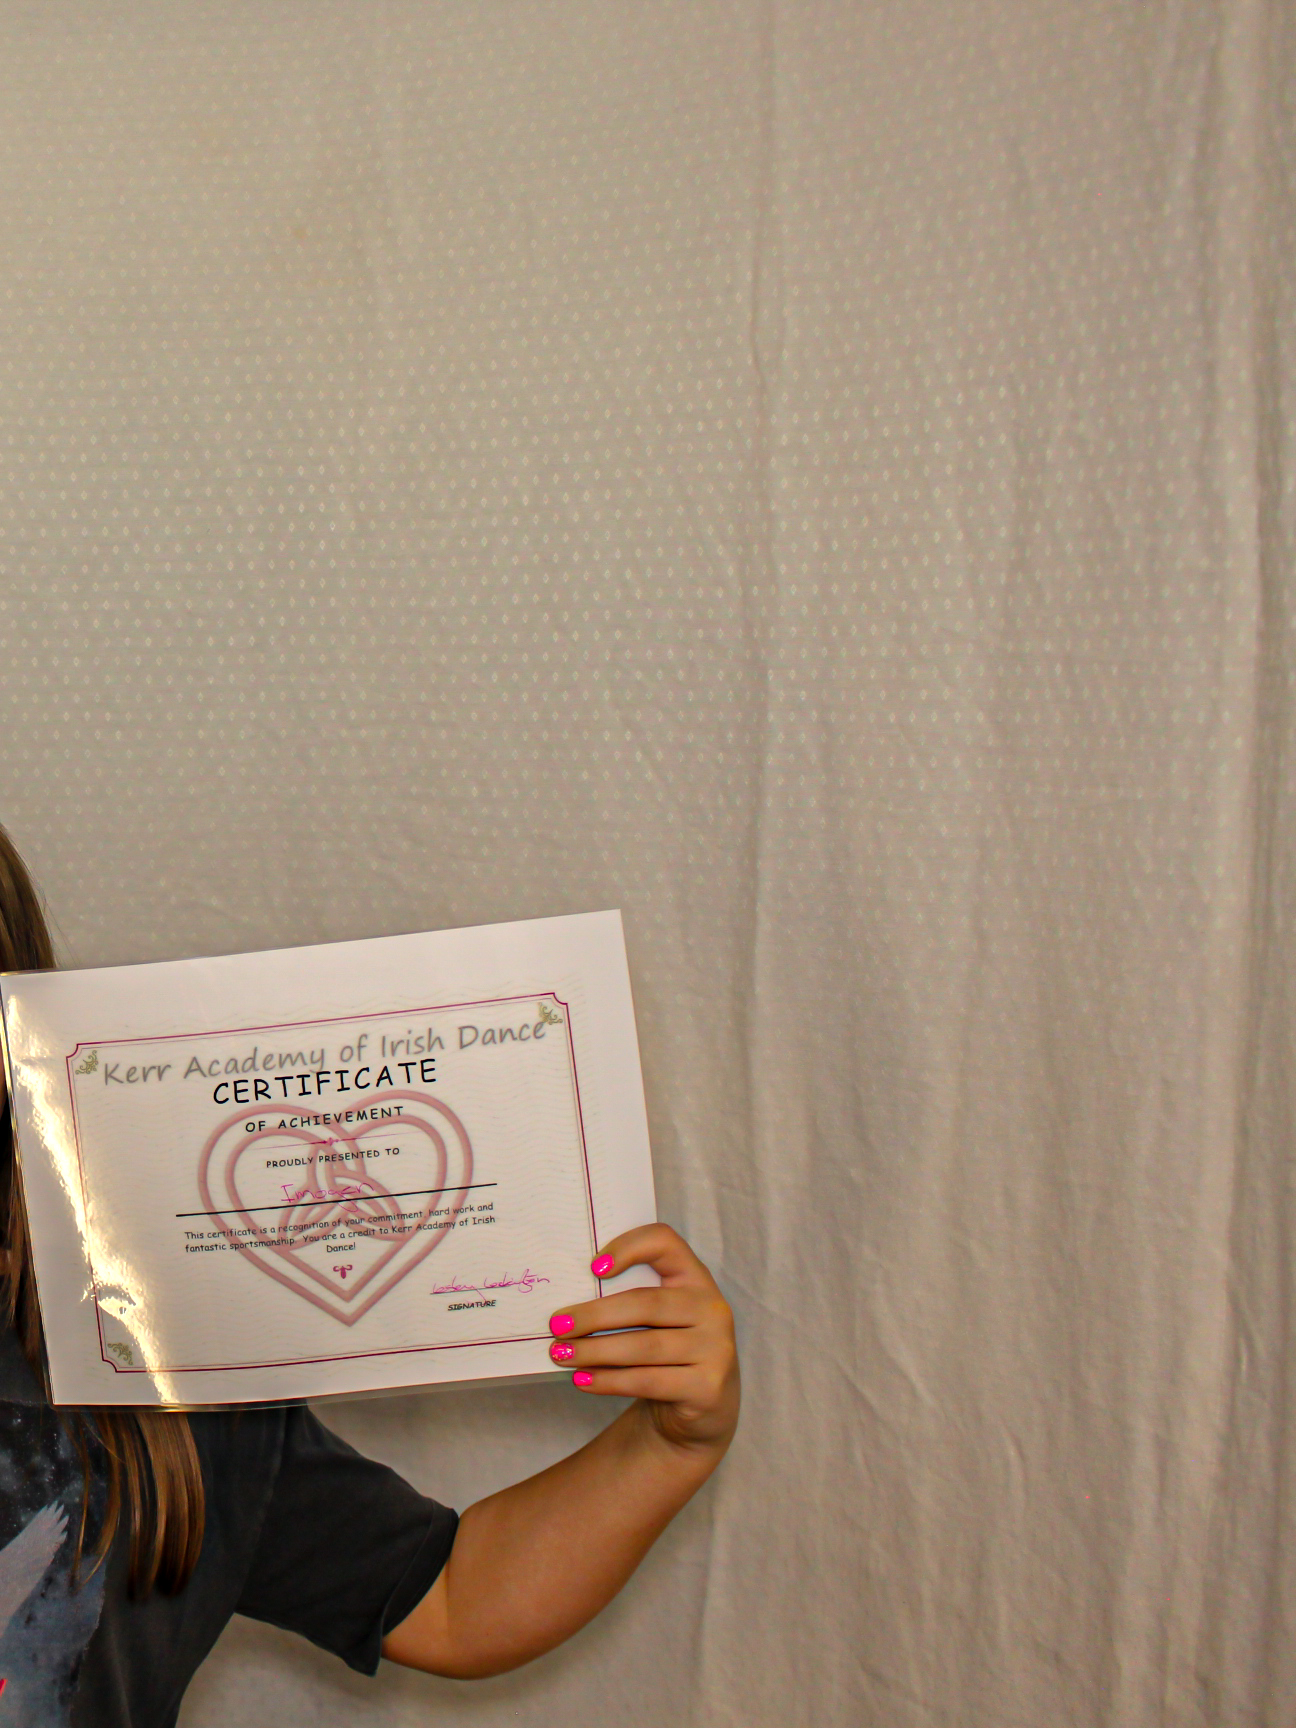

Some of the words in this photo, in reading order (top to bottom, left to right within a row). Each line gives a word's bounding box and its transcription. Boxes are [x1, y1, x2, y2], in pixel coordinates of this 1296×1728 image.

[104, 1062, 172, 1086] Kerr
[183, 1046, 326, 1080] Academy
[340, 1033, 369, 1062] of
[380, 1027, 445, 1058] Irish
[457, 1021, 546, 1050] Dance
[212, 1058, 437, 1105] CERTIFICATE
[245, 1120, 267, 1133] OF
[277, 1105, 404, 1130] ACHIEVEMENT
[266, 1157, 314, 1168] PROUDLY
[318, 1149, 380, 1163] PRESENTED
[385, 1147, 400, 1156] TO
[280, 1182, 376, 1213] Imogen
[184, 1231, 204, 1240] This
[207, 1227, 257, 1239] certificate
[259, 1225, 267, 1234] is
[278, 1221, 330, 1233] recognition
[332, 1217, 342, 1227] of
[344, 1218, 365, 1228] your
[429, 1206, 450, 1217] hard
[453, 1204, 475, 1214] work
[477, 1202, 494, 1212] and
[185, 1243, 227, 1254] fantastic
[303, 1234, 320, 1243] You
[322, 1233, 338, 1241] are
[347, 1227, 376, 1238] credit
[379, 1226, 389, 1235] to
[392, 1224, 413, 1234] Kerr
[415, 1220, 456, 1232] Academy
[459, 1217, 470, 1227] of
[472, 1214, 496, 1225] Irish
[326, 1241, 356, 1253] Dance!
[447, 1299, 497, 1312] SIGNATURE
